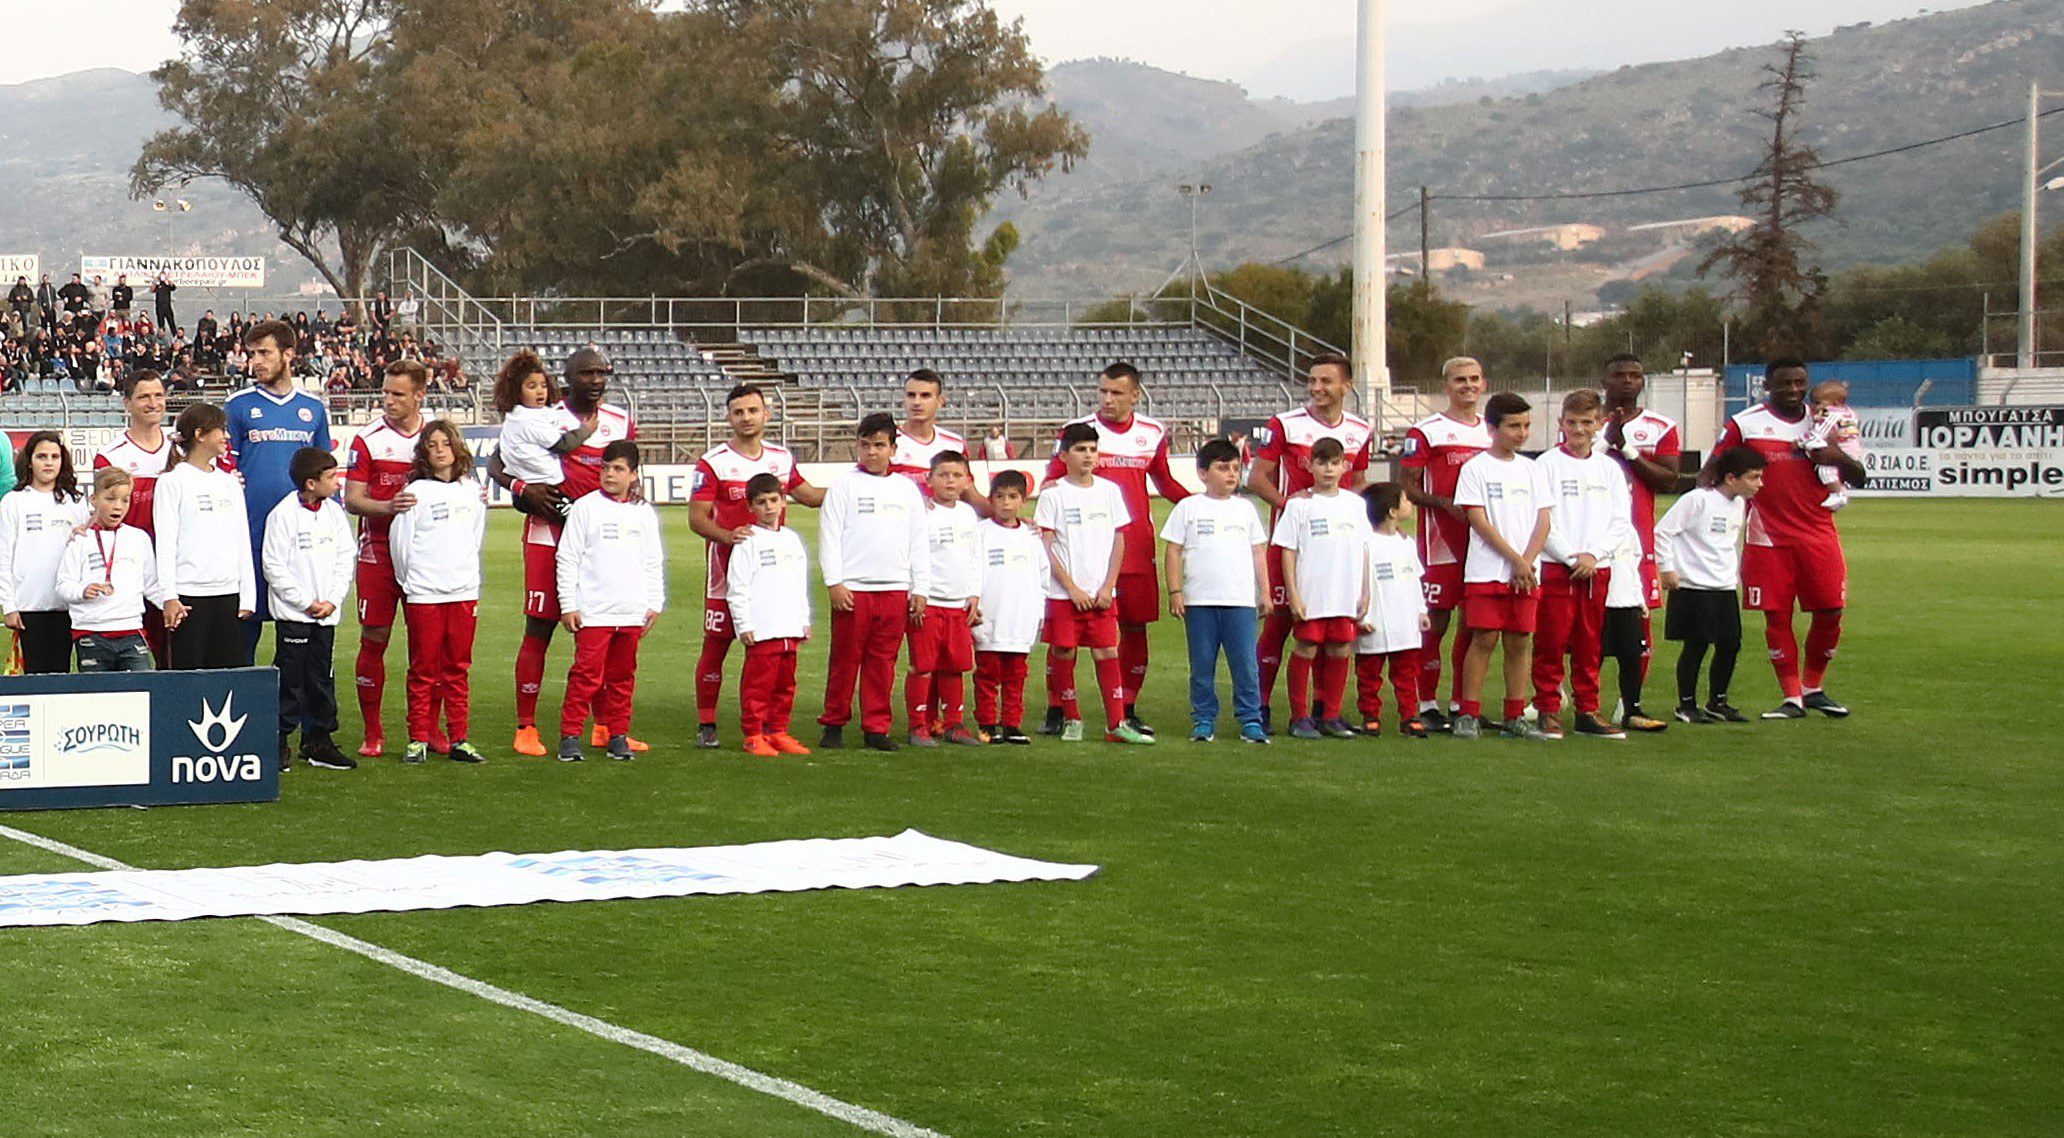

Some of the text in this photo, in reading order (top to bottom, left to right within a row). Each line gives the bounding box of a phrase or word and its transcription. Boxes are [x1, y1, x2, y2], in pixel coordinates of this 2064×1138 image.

[109, 258, 261, 271] ΓΙΑΝΝΑΚΟΠΟΥΛΟΣ
[1949, 410, 2053, 422] ΜΠΟΥΓΑΤΣΑ
[1866, 453, 1876, 470] &
[1880, 455, 1901, 470] ΣΙΑ
[1938, 461, 2064, 491] simple
[528, 590, 545, 613] 17
[706, 609, 725, 632] 82
[63, 723, 141, 752] ΣΟΥΡΩΤΗ
[171, 754, 262, 783] nova
